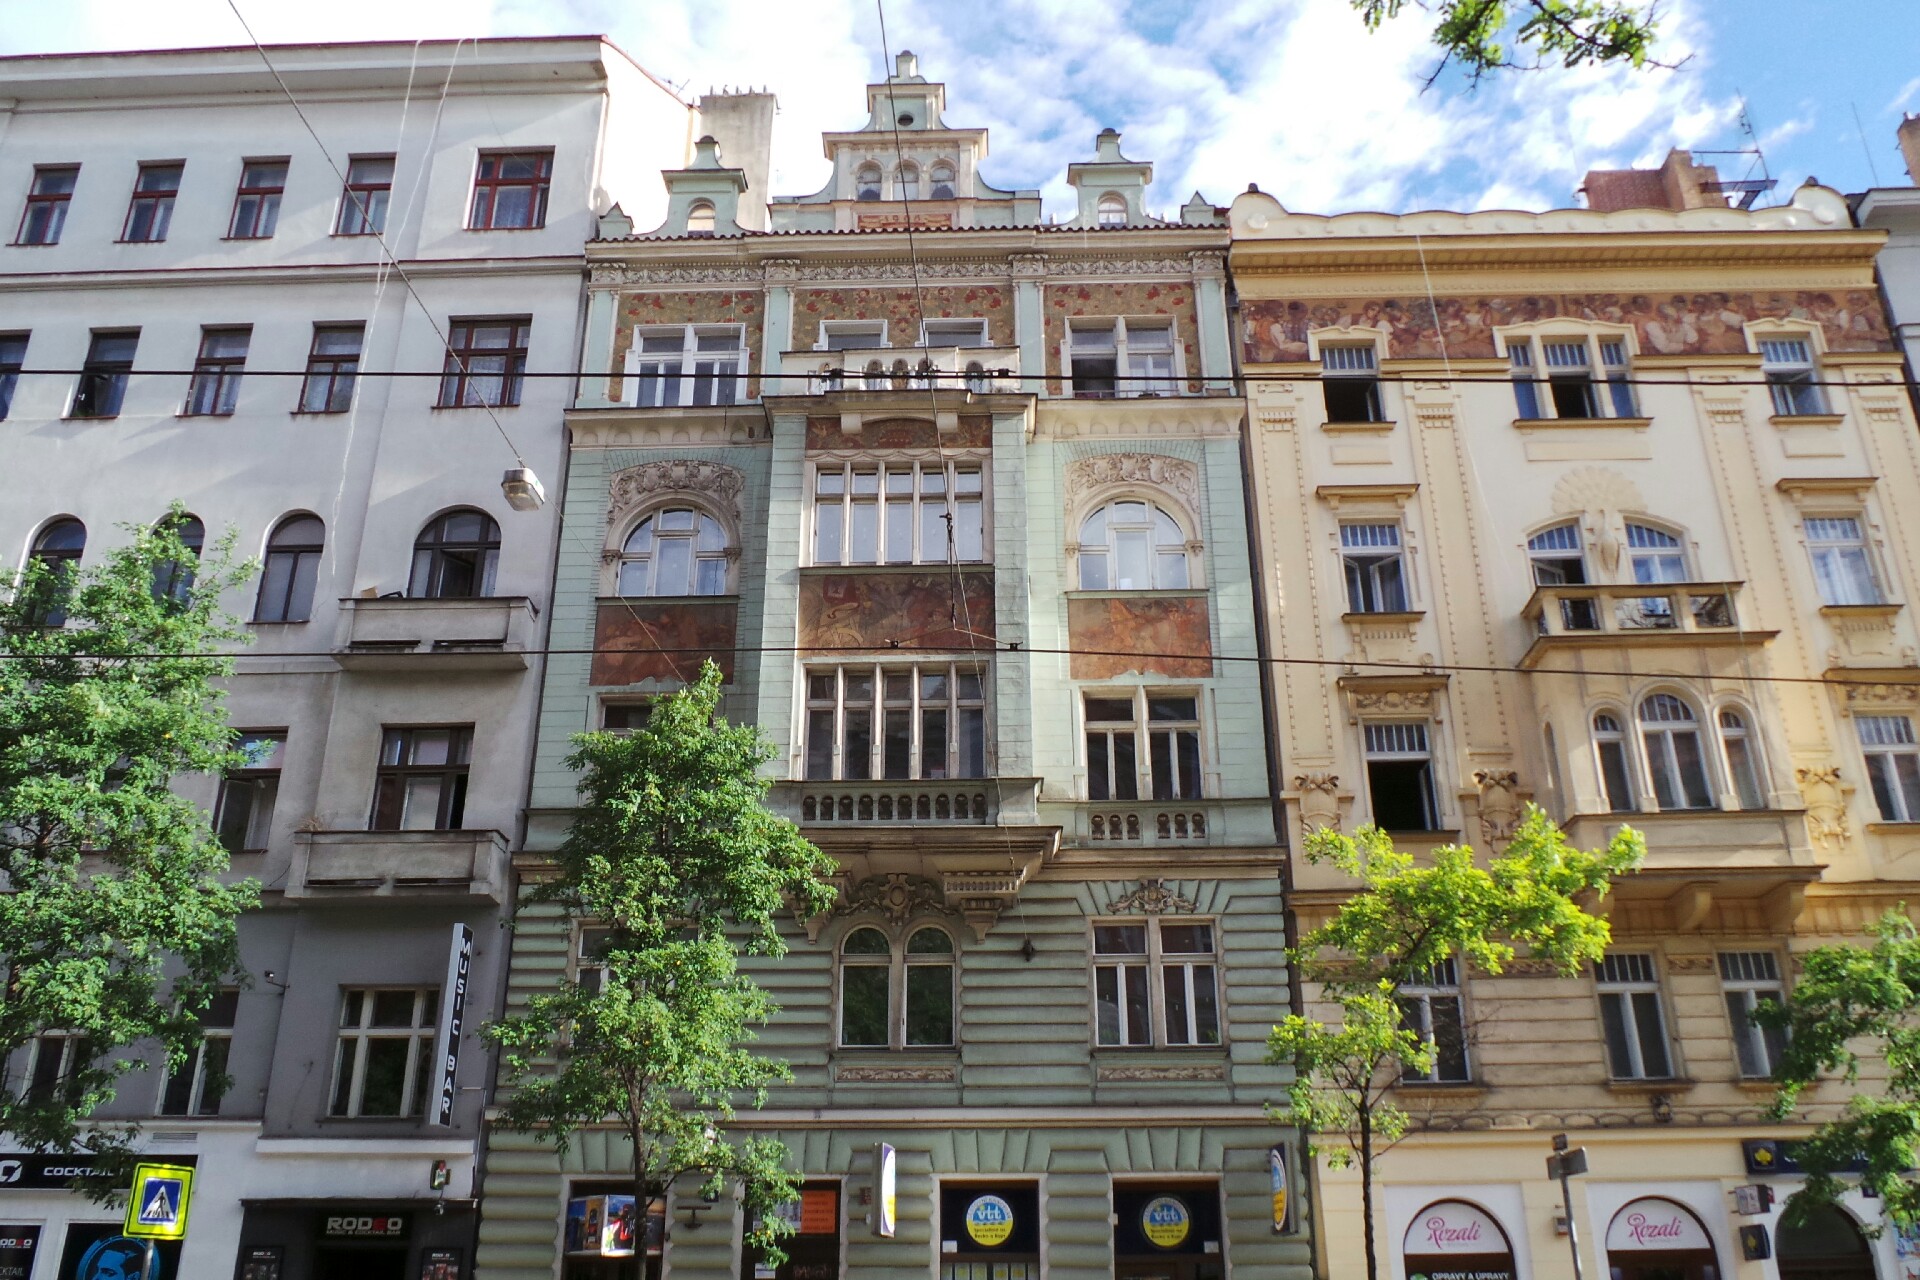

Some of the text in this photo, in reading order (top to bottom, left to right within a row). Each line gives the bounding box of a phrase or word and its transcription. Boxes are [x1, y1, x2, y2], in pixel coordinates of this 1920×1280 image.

[441, 937, 471, 1114] MUSIC BAR
[327, 1217, 403, 1231] RODEO
